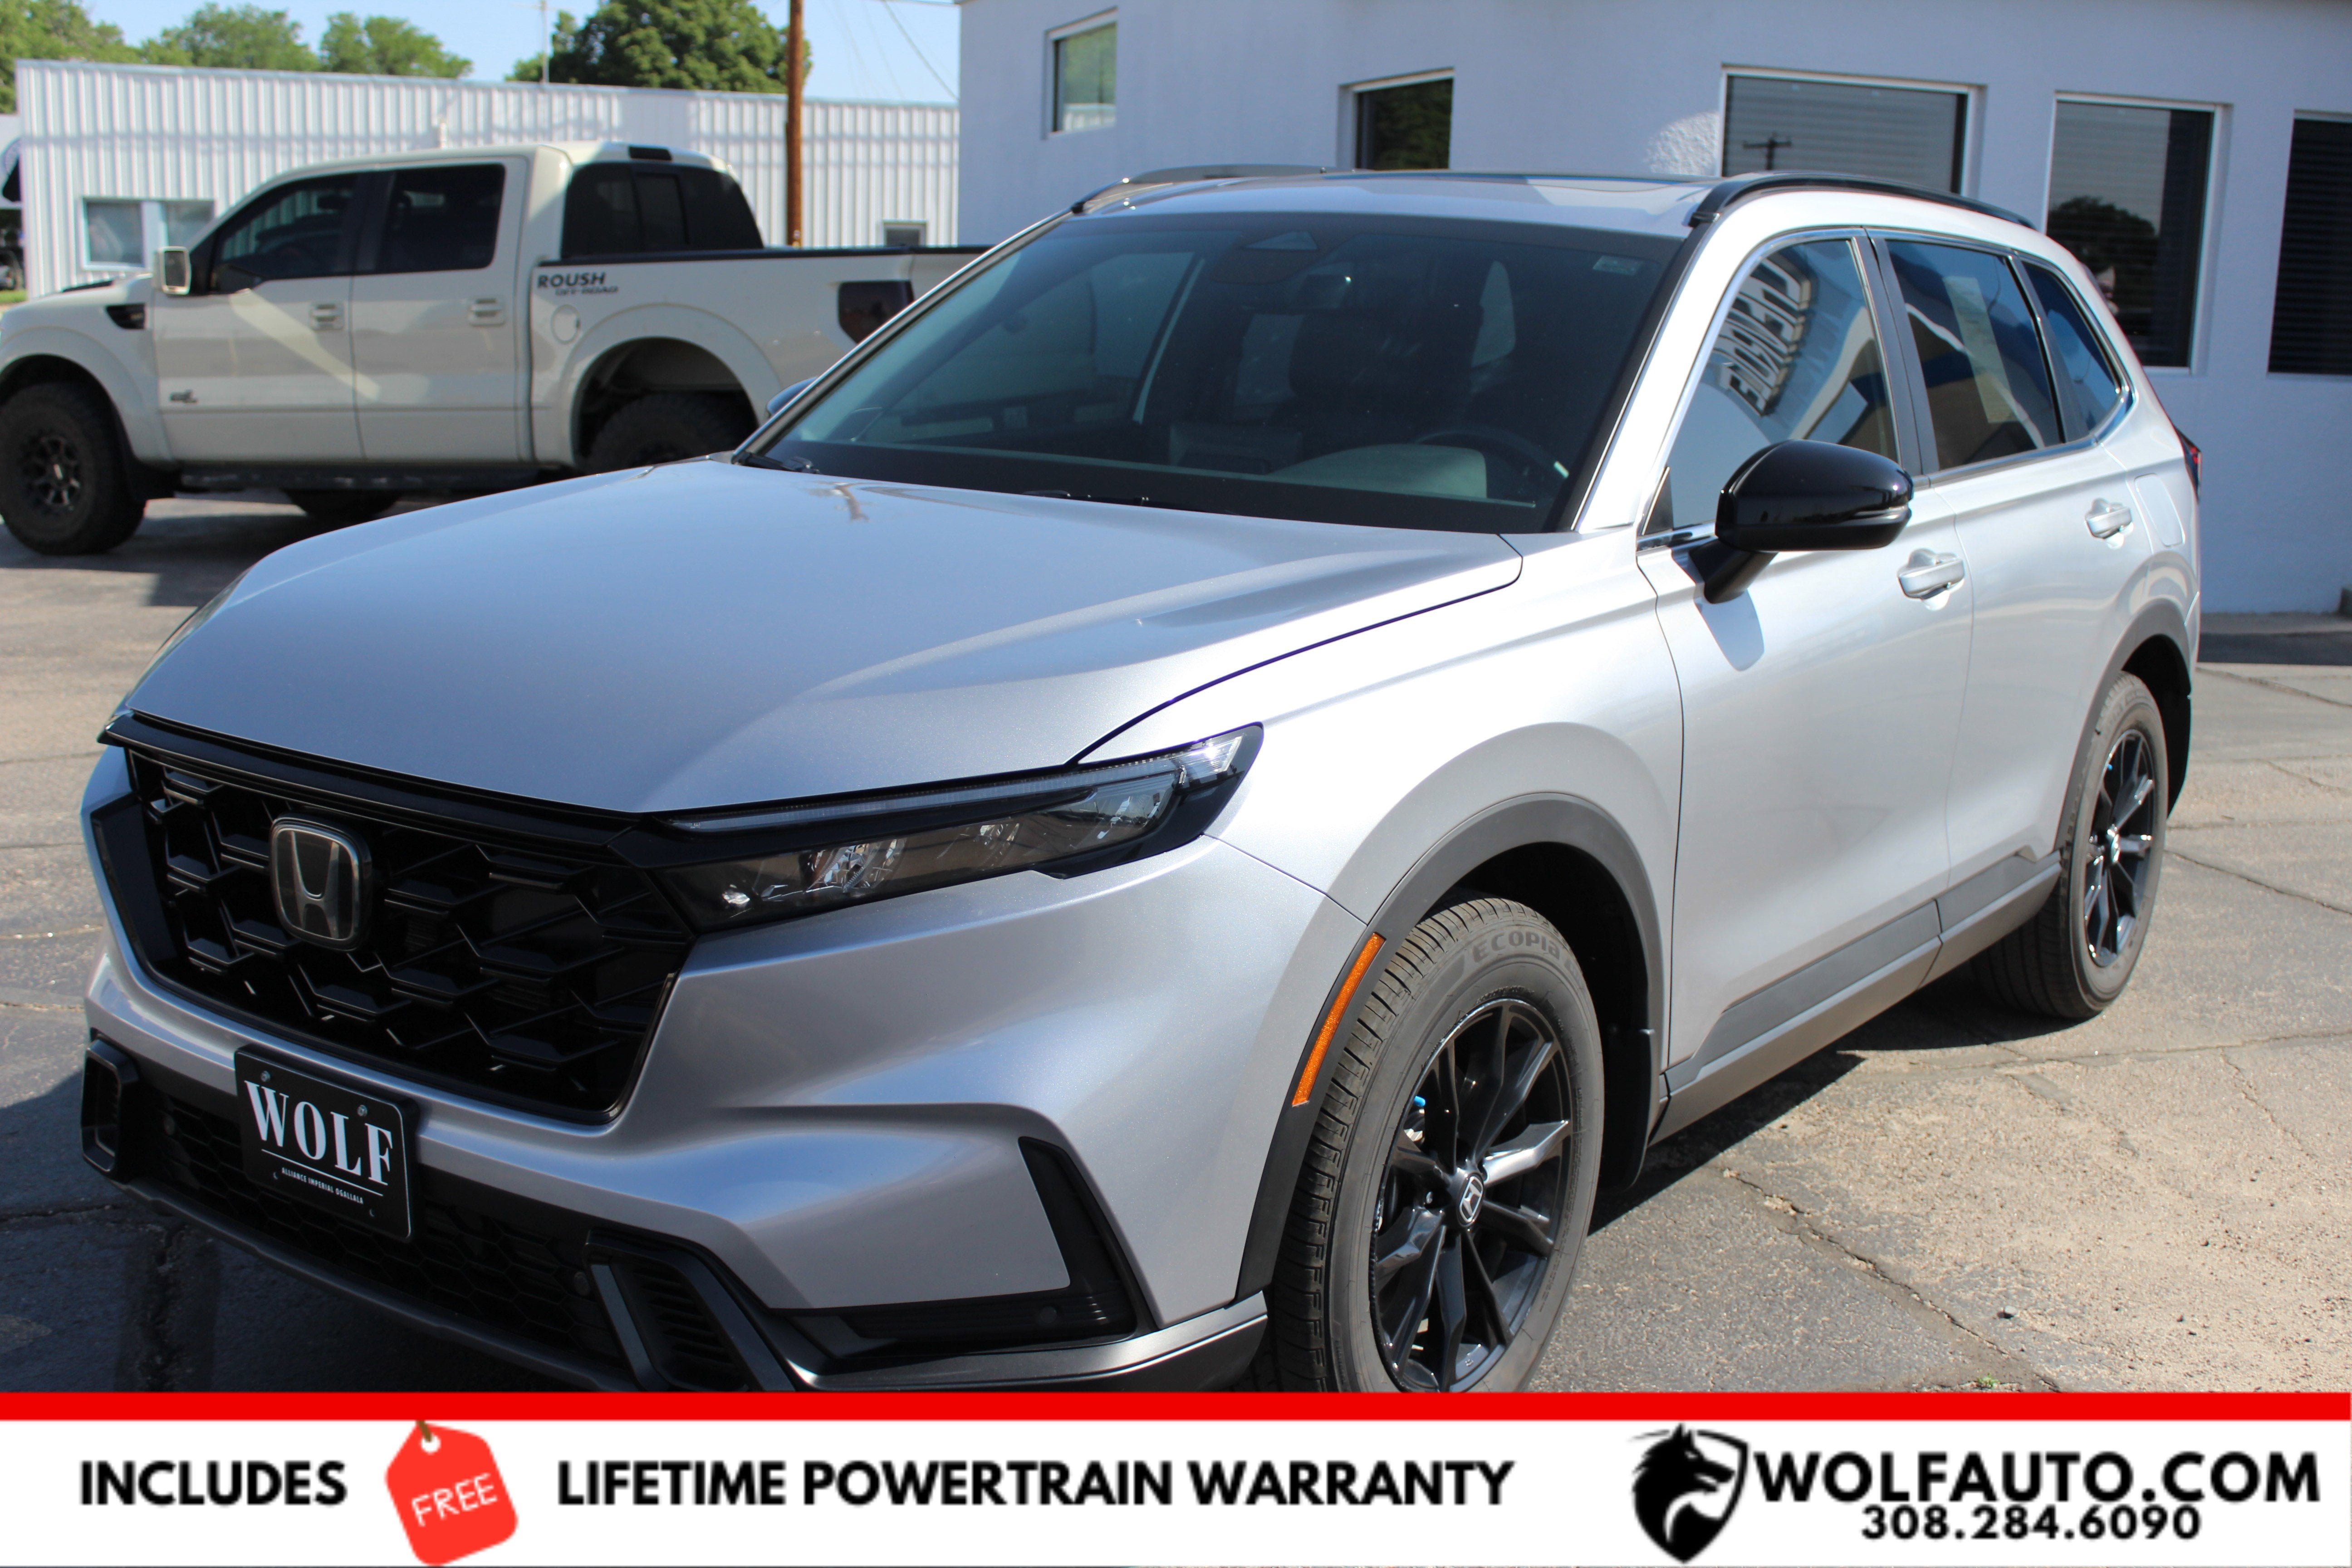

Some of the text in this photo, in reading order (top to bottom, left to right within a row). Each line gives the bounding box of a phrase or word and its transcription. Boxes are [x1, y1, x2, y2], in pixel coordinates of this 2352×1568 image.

[537, 272, 606, 288] ROUSH
[244, 1080, 393, 1186] WOLF
[281, 1167, 363, 1204] ALLIANCE IMPERIAL OGALLALA
